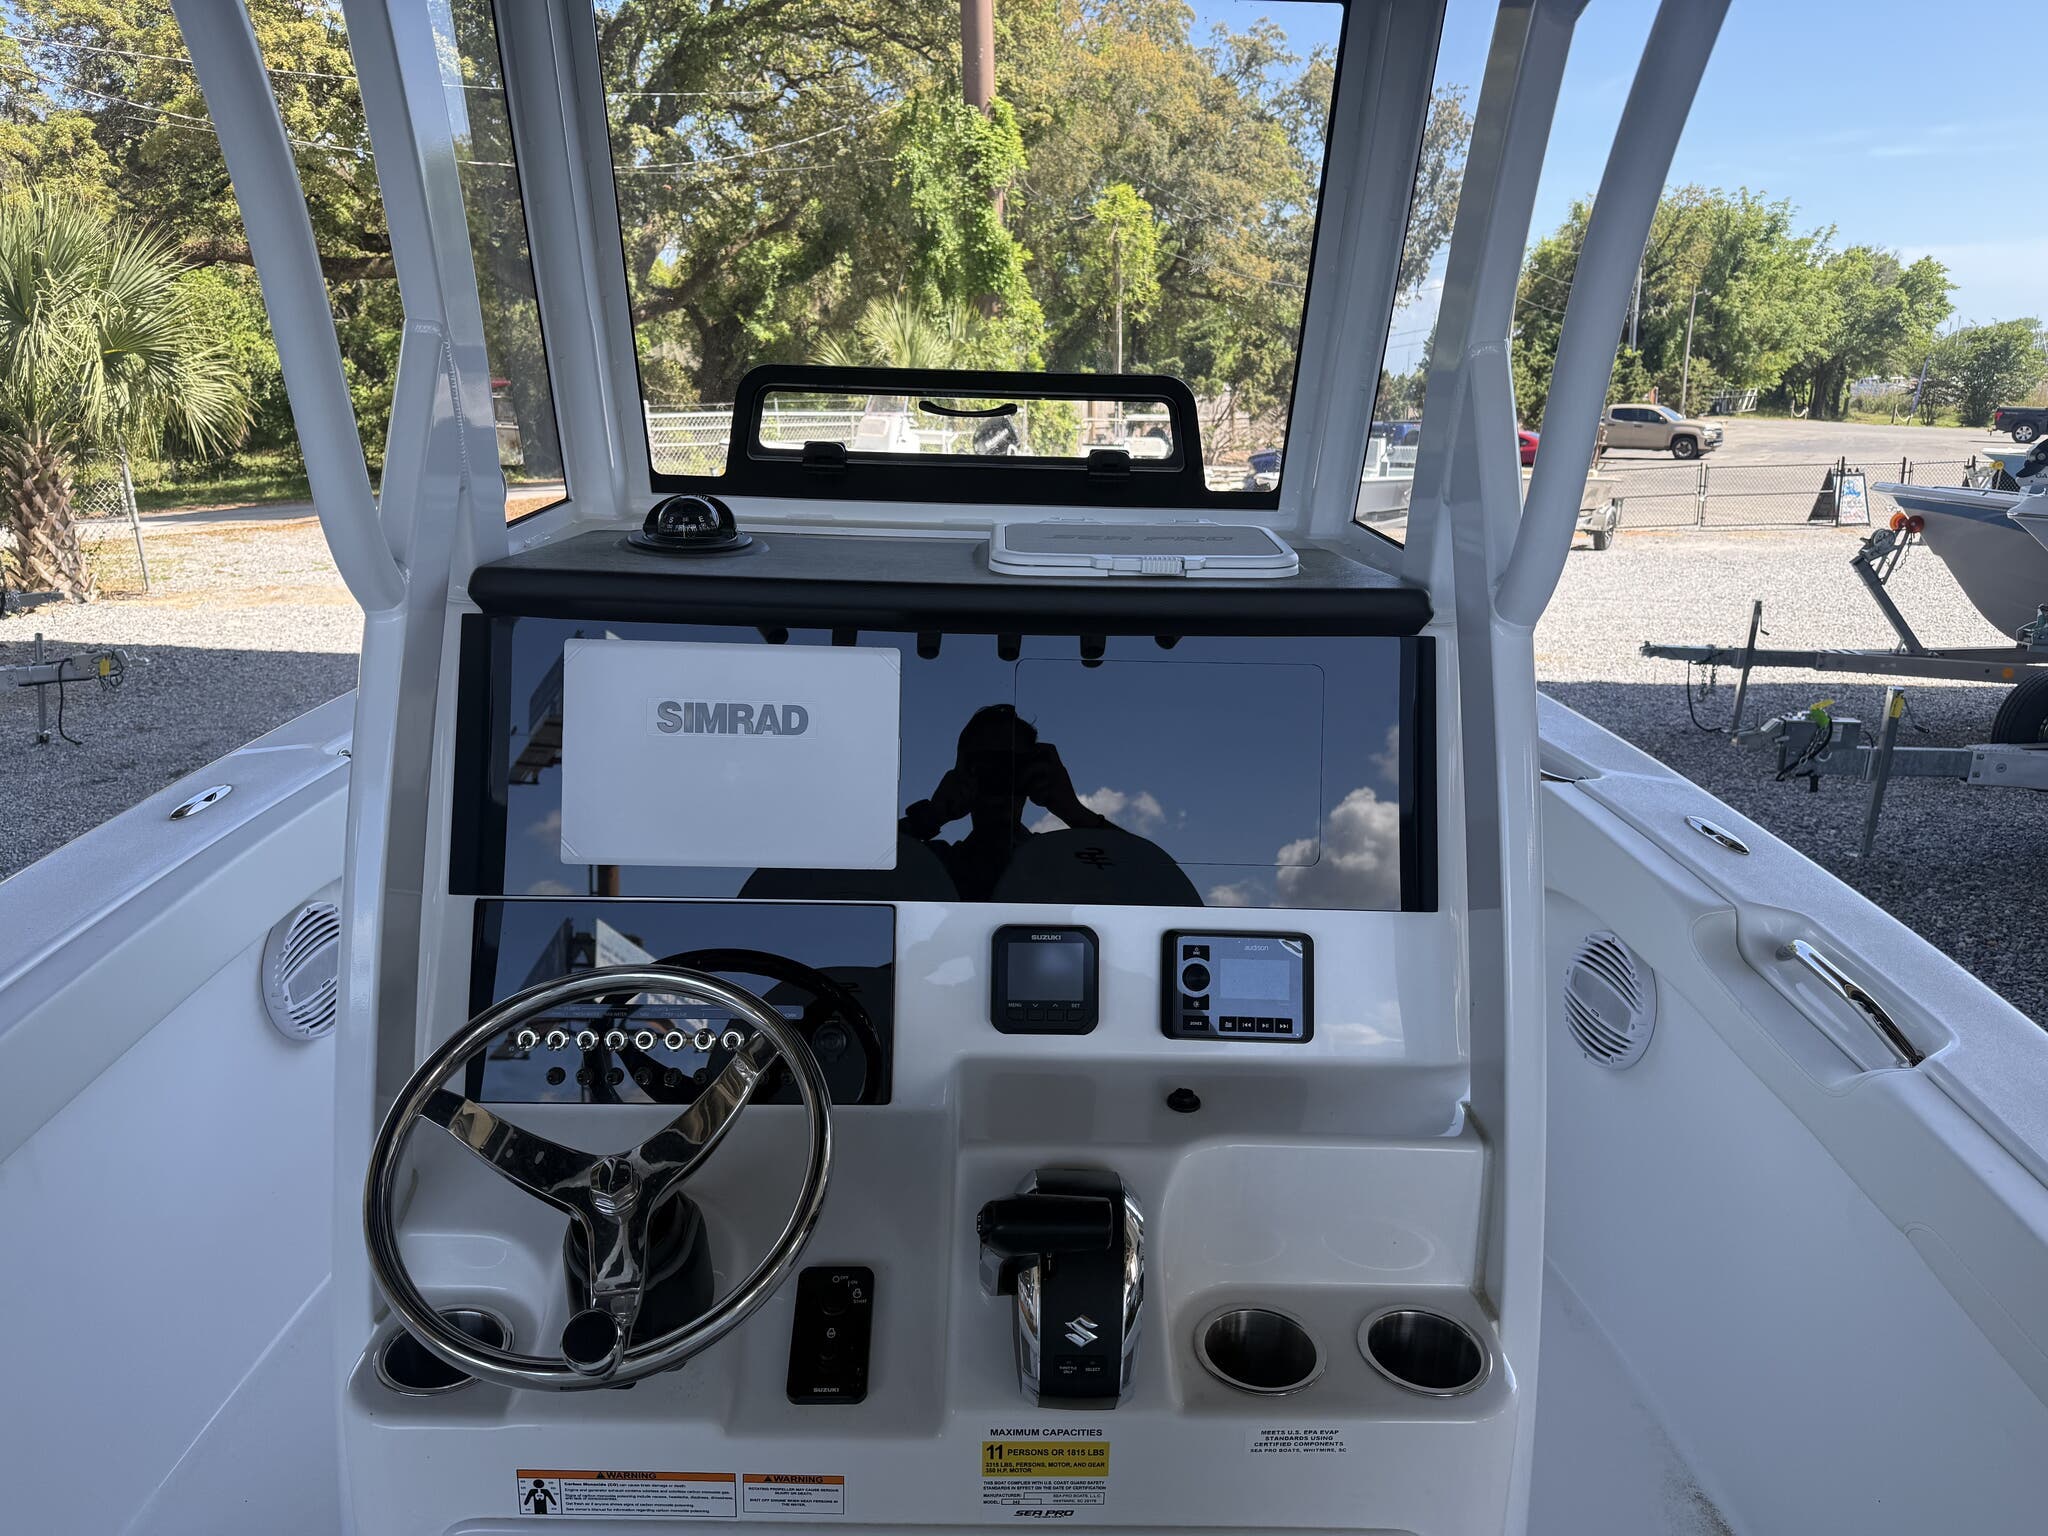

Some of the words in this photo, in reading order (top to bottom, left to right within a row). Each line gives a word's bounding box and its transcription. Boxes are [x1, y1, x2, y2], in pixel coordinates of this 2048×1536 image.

[698, 515, 705, 523] E
[656, 701, 809, 736] SIMRAD
[990, 1429, 1040, 1437] MAXIMUM
[1042, 1429, 1103, 1437] CAPACITIES
[986, 1444, 1003, 1460] 11
[606, 1472, 656, 1480] WARNING
[773, 1475, 824, 1484] WARNING
